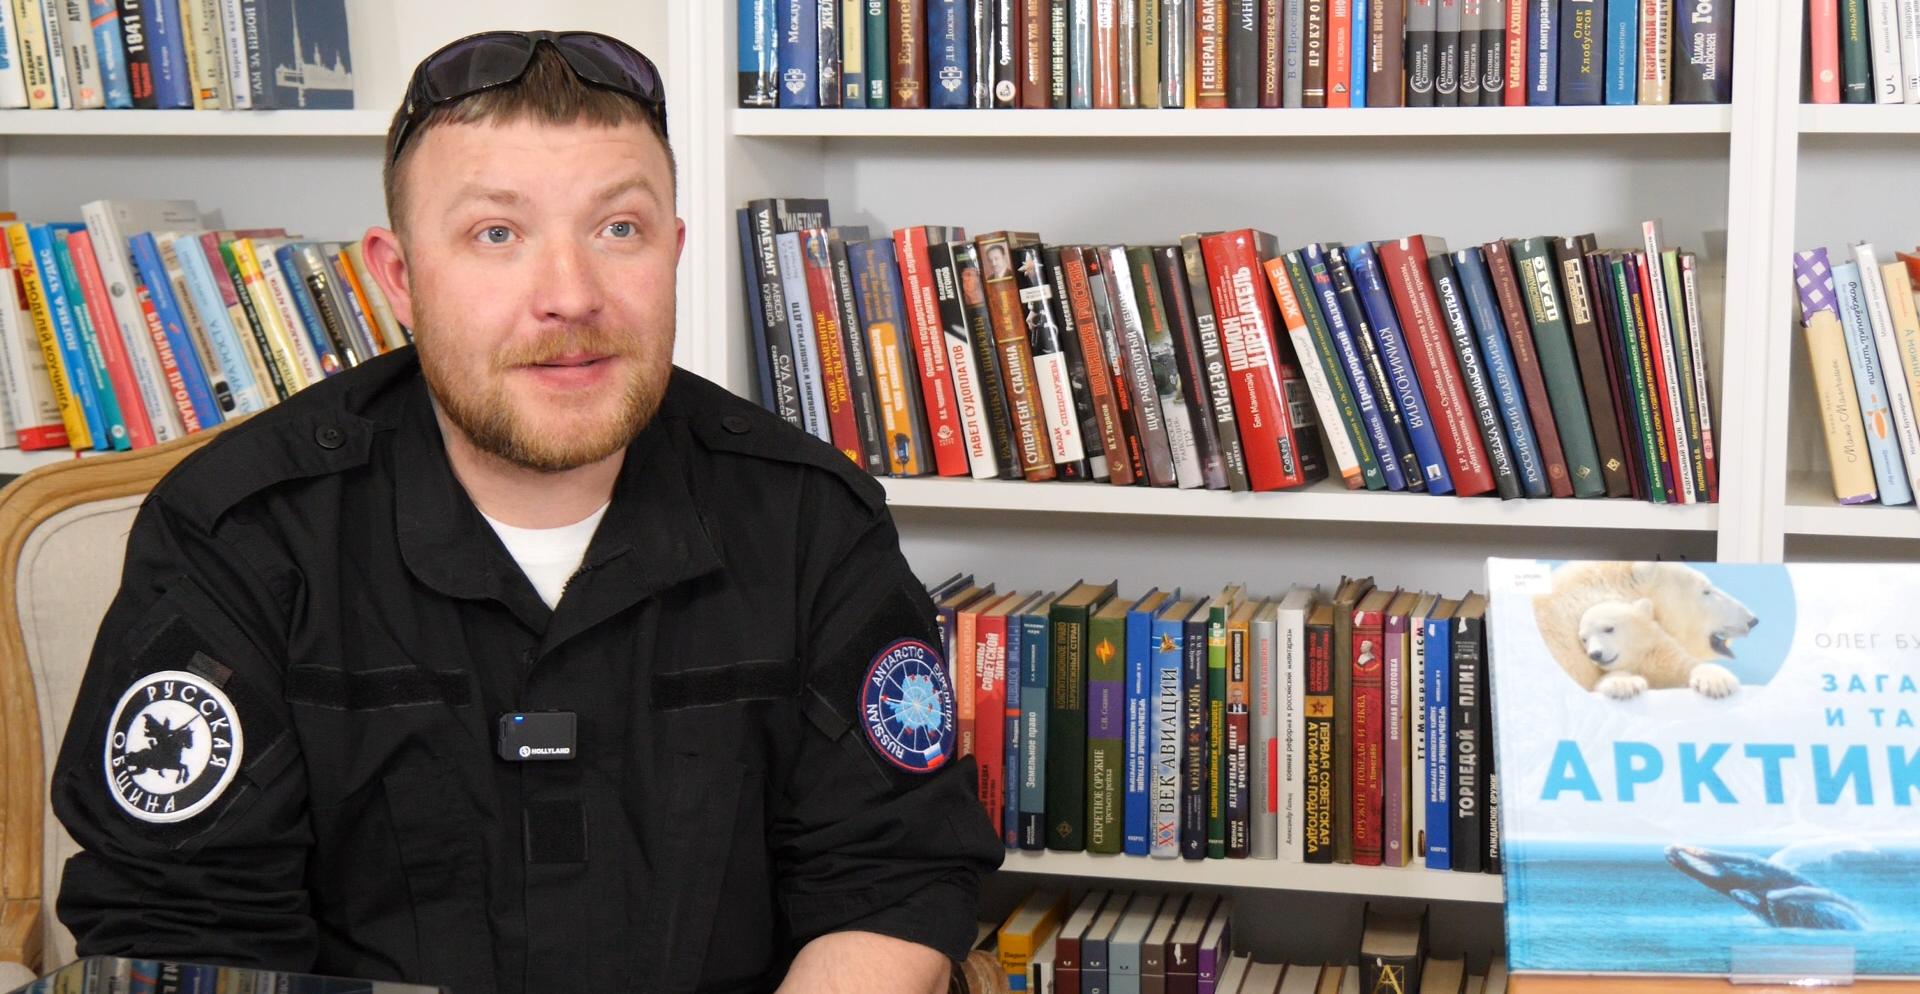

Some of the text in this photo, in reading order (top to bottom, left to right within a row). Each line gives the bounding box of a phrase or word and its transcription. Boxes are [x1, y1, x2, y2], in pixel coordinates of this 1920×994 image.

[243, 7, 259, 50] НЕВОЙ
[1573, 8, 1583, 38] Олег
[1581, 8, 1592, 72] Хлобустов
[1691, 32, 1705, 64] Киммо
[21, 38, 38, 86] ВЛАДИМИР
[249, 52, 260, 67] ЗА
[1202, 36, 1214, 88] ГЕНЕРАЛ
[1509, 37, 1521, 87] ТЕРРОРА
[1536, 52, 1547, 91] Военная
[38, 246, 78, 352] ЛОГИКА ЧУДЕС
[837, 259, 851, 300] ПЯТЕРКА
[940, 266, 953, 299] АНТОНОВ
[1053, 264, 1074, 331] Русская полиция
[1270, 266, 1299, 319] ЖИЛЬЕ
[1398, 262, 1423, 318] гражданском,
[1406, 254, 1425, 291] процессе
[1532, 255, 1558, 321] ПРАВО
[762, 283, 775, 326] КУЗНЕЦОВ
[770, 282, 784, 320] АЛЕКСЕЙ
[921, 286, 936, 325] политики
[1230, 265, 1269, 367] И ПРЕДАТЕЛЬ
[1418, 291, 1438, 334] уголовном
[1438, 275, 1466, 336] ВЫСТРЕЛОВ
[19, 259, 73, 410] 76 МОДЕЛЕЙ КОУЧИНГА
[826, 319, 847, 401] ЮРИСТЫ РОССИИ
[844, 301, 865, 376] КЕМБРИДЖСКАЯ
[928, 325, 944, 364] кадровой
[1221, 316, 1248, 371] ШПИОН
[1417, 324, 1439, 368] экспертиза
[1456, 335, 1469, 347] И
[1846, 280, 1875, 385] Рождённый читать
[143, 311, 174, 370] БИБЛИЯ
[166, 369, 198, 431] ПРОДАЖ
[778, 353, 791, 379] СУД
[815, 310, 839, 413] САМЫЕ ЗНАМЕНИТЫЕ
[1004, 344, 1024, 394] СТАЛИНА
[1123, 330, 1153, 402] РАСКОЛОТЫЙ
[1197, 313, 1233, 423] ЕЛЕНА ФЕРРАРИ
[1321, 288, 1395, 471] В.П. Рябцев. Прокурорский надзор
[1377, 325, 1424, 428] КРИМИНОЛОГИЯ
[1431, 368, 1451, 407] Судебная
[1432, 339, 1465, 417] административном
[1460, 345, 1489, 408] ВЫМЫСЛОВ
[1485, 333, 1514, 404] ФЕДЕРАЛИЗМ
[782, 383, 793, 402] ДА
[952, 344, 983, 457] ПАВЕЛ СУДОПЛАТОВ
[1142, 402, 1159, 431] ЩИТ.
[1243, 371, 1261, 428] Бен Макинтайр
[1480, 407, 1494, 425] БЕЗ
[1015, 398, 1038, 464] СУПЕРАГЕНТ
[1053, 426, 1066, 457] ЛЮДИ
[1182, 428, 1194, 447] ГРУ
[1442, 406, 1464, 454] Россинская.
[1456, 416, 1482, 474] арбитражном,
[1486, 426, 1511, 476] РАЗВЕДКА
[1506, 405, 1538, 483] РОССИЙСКИЙ
[1225, 450, 1234, 467] ЛОТА
[1458, 454, 1469, 471] Е.Р.
[872, 646, 924, 687] ANTARCTIC
[982, 632, 999, 692] СОВЕТСКОЙ
[1815, 632, 1881, 649] ОЛЕГ
[932, 663, 953, 731] EXPEDITION
[1459, 663, 1474, 705] ПЛИ!
[1821, 674, 1918, 693] ЗАГА
[147, 682, 230, 768] РУССКАЯ
[867, 703, 905, 759] RUSSIAN
[1228, 723, 1237, 749] ЩИТ
[1824, 707, 1915, 727] И ТА
[113, 732, 176, 812] ОБЩИНА
[1026, 711, 1037, 787] Земельное право
[1159, 668, 1176, 846] XX ВЕК АВИАЦИИ
[1456, 729, 1475, 817] ТОРПЕДОЙ
[1093, 749, 1104, 843] СЕКРЕТНОЕ ОРУЖИЕ
[1104, 768, 1113, 823] третьего рейха
[1306, 721, 1318, 852] АТОМНАЯ ПОДЛОДКА
[1319, 721, 1330, 844] ПЕРВАЯ СОВЕТСКАЯ
[1488, 772, 1498, 857] ГРАЖДАНСКОЕ ОРУЖИЕ
